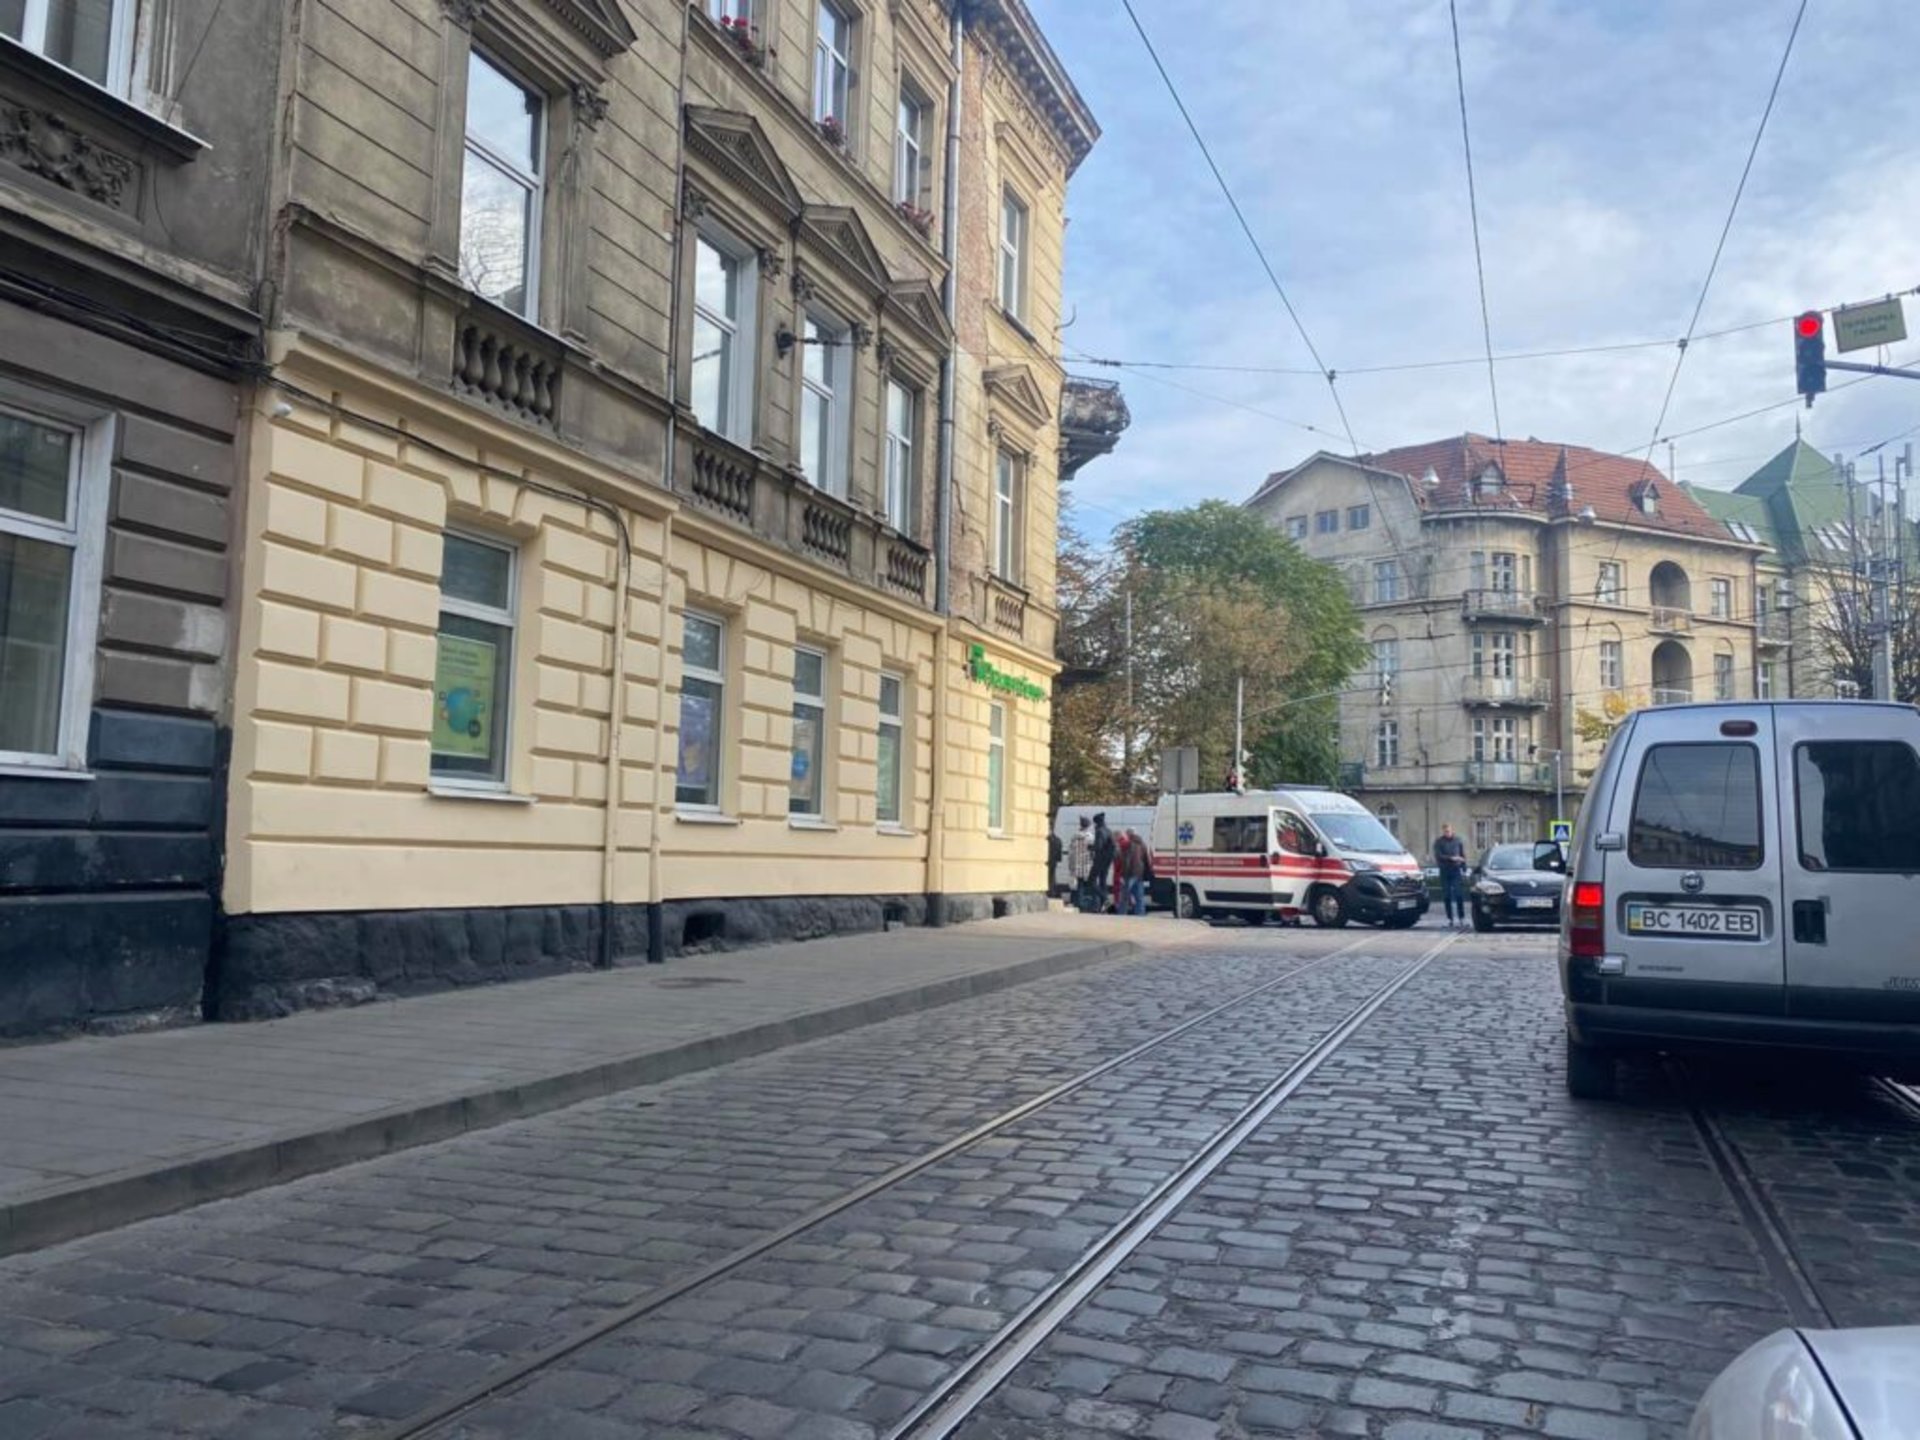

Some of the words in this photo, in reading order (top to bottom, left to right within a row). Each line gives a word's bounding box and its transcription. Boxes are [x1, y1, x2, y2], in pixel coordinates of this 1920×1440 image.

[1643, 911, 1670, 928] BC
[1677, 912, 1720, 931] 1402
[1725, 915, 1754, 932] EB
